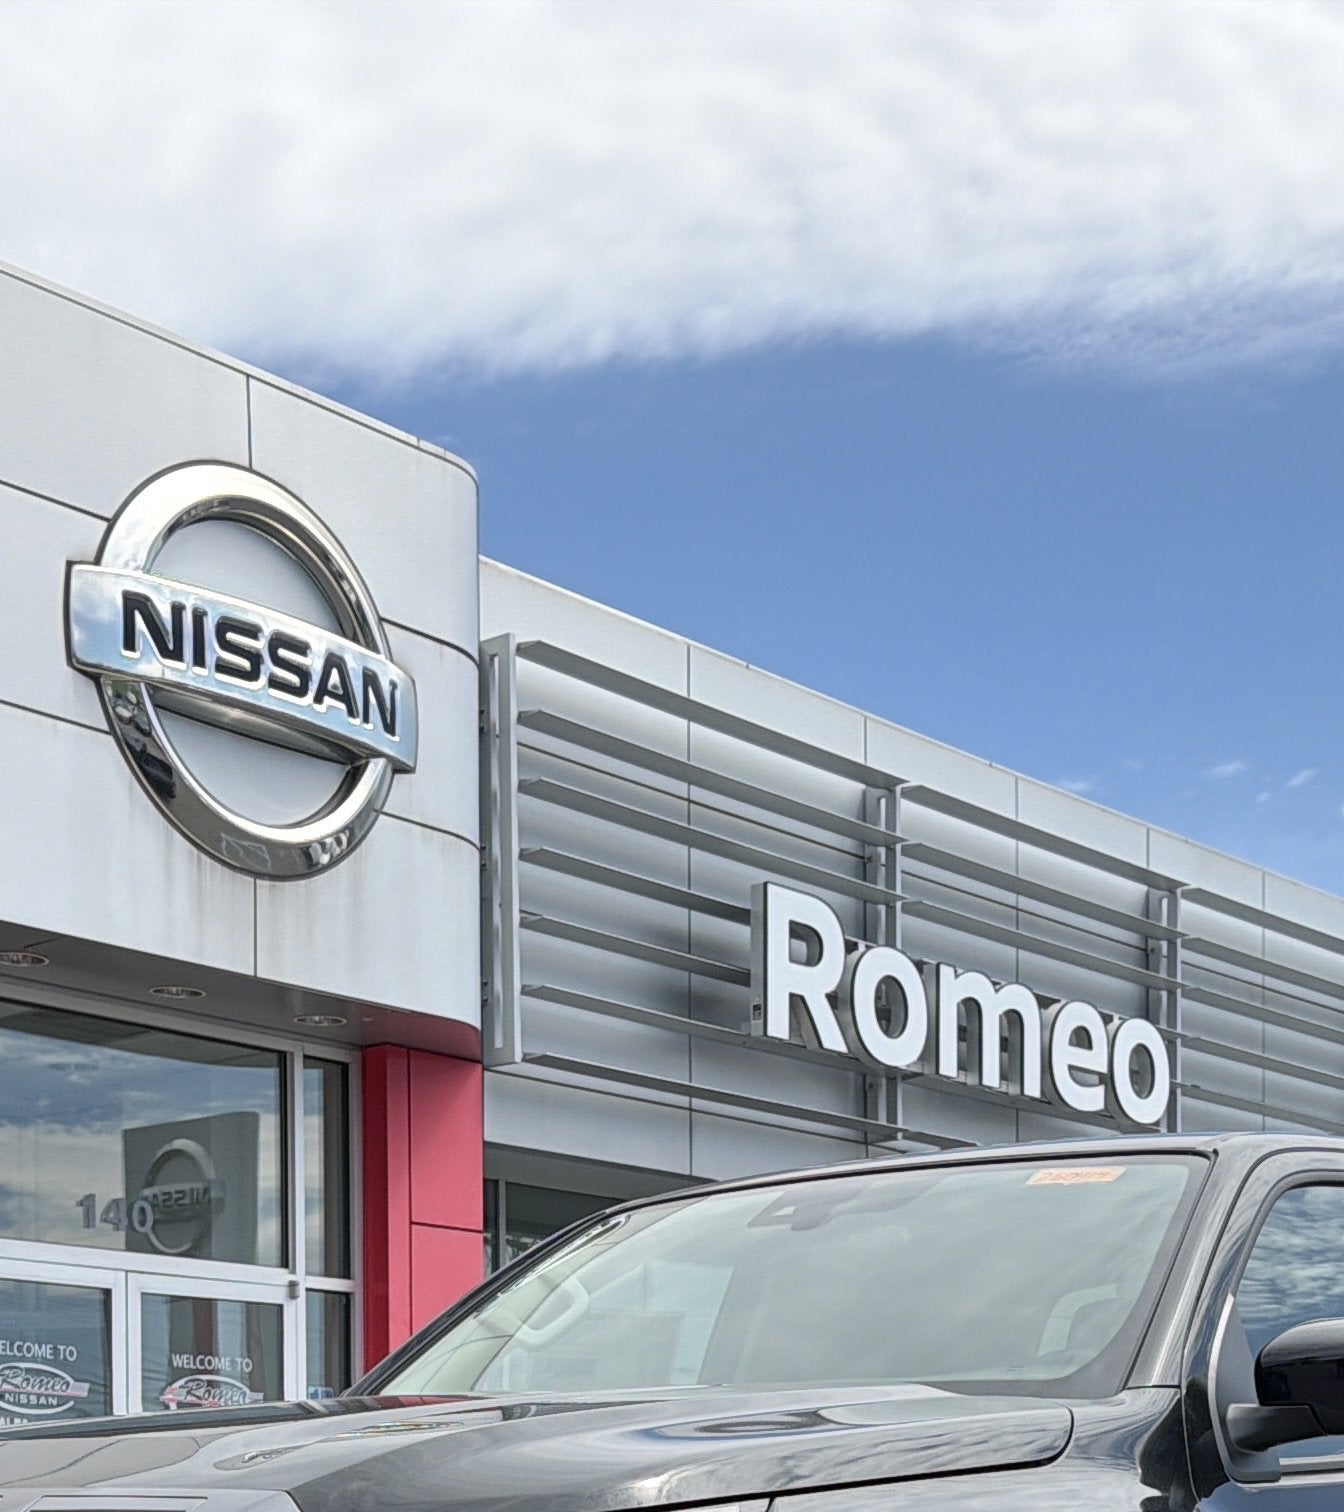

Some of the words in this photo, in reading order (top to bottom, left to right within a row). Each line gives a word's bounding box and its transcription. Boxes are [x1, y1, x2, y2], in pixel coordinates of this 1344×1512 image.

[121, 589, 399, 741] NISSAN
[762, 881, 1171, 1125] Romeo
[76, 1193, 154, 1232] 140
[57, 1345, 78, 1361] TO
[171, 1353, 232, 1371] WELCOME
[237, 1358, 253, 1373] TO
[4, 1393, 58, 1406] NISSAN
